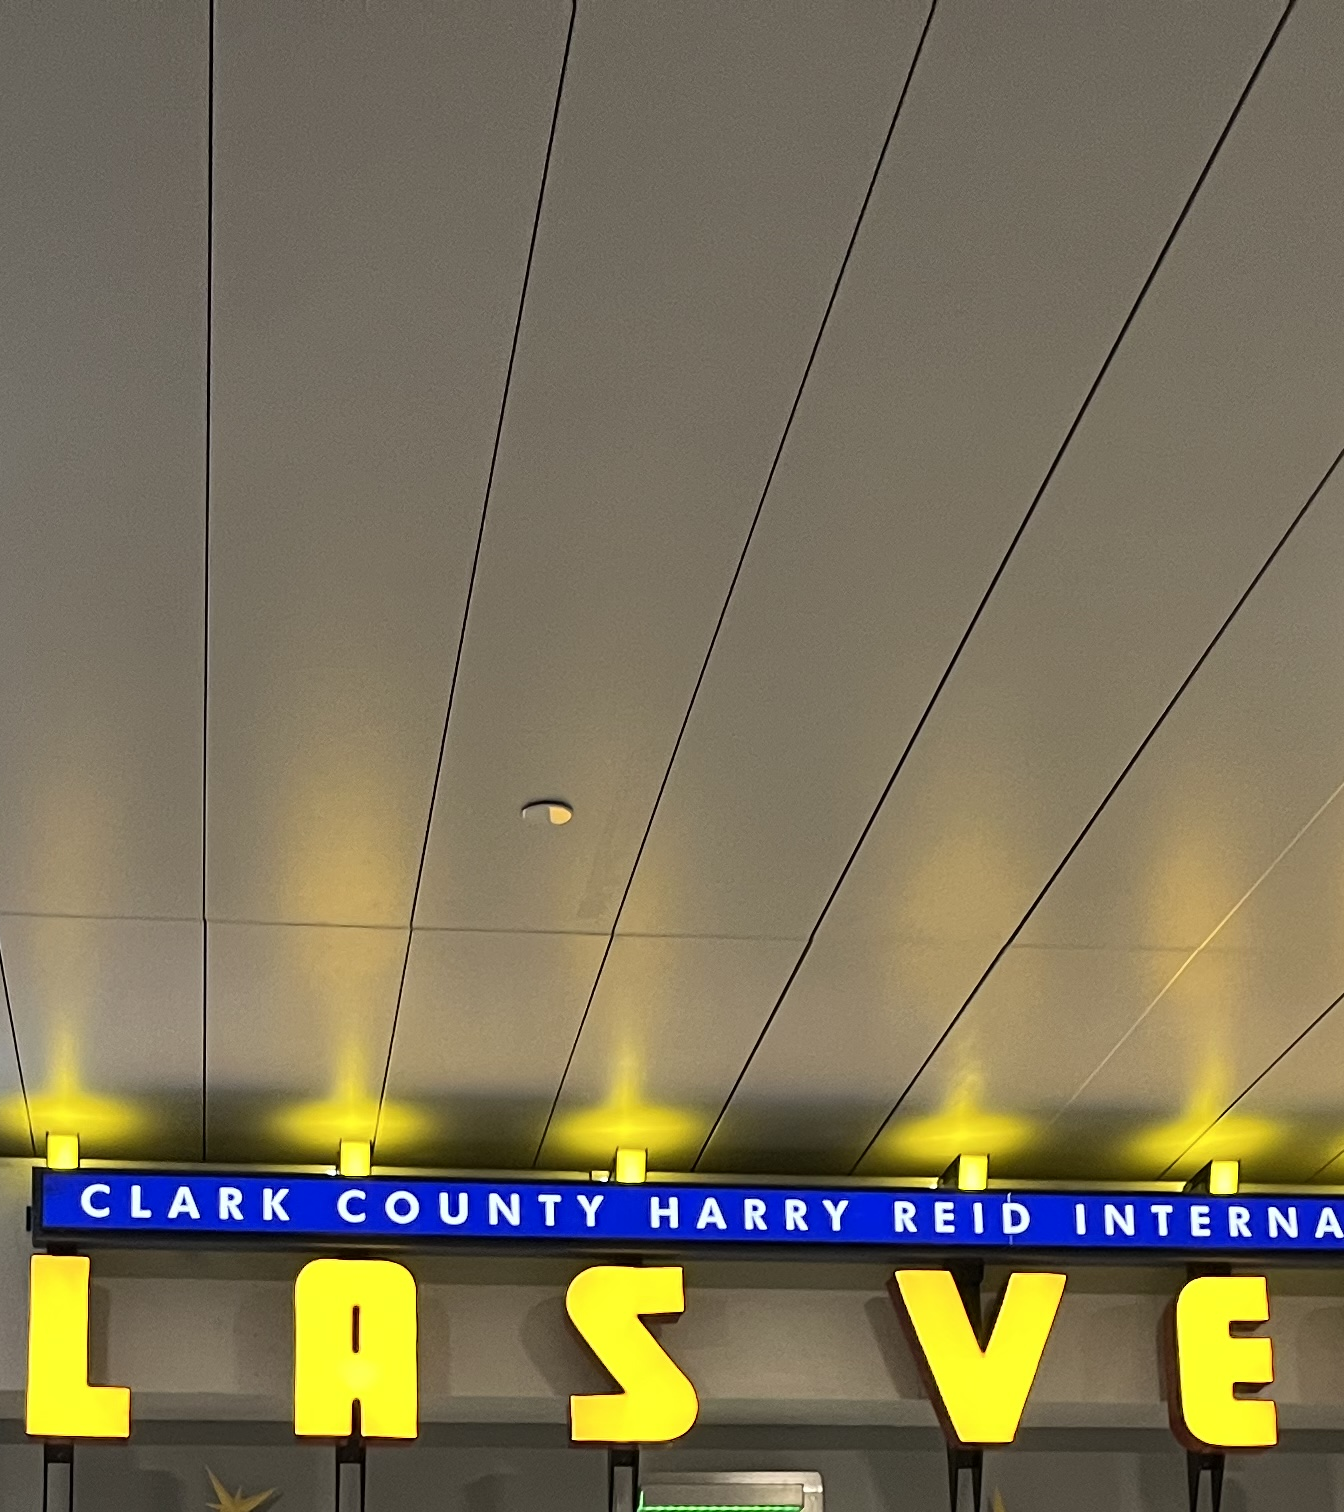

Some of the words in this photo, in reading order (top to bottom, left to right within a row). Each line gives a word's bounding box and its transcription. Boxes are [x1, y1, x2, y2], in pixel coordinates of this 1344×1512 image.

[80, 1183, 290, 1221] CLARK
[336, 1188, 604, 1227] COUNTY
[650, 1196, 849, 1232] HARRY
[893, 1200, 1031, 1236] REID
[25, 1254, 699, 1442] LAS
